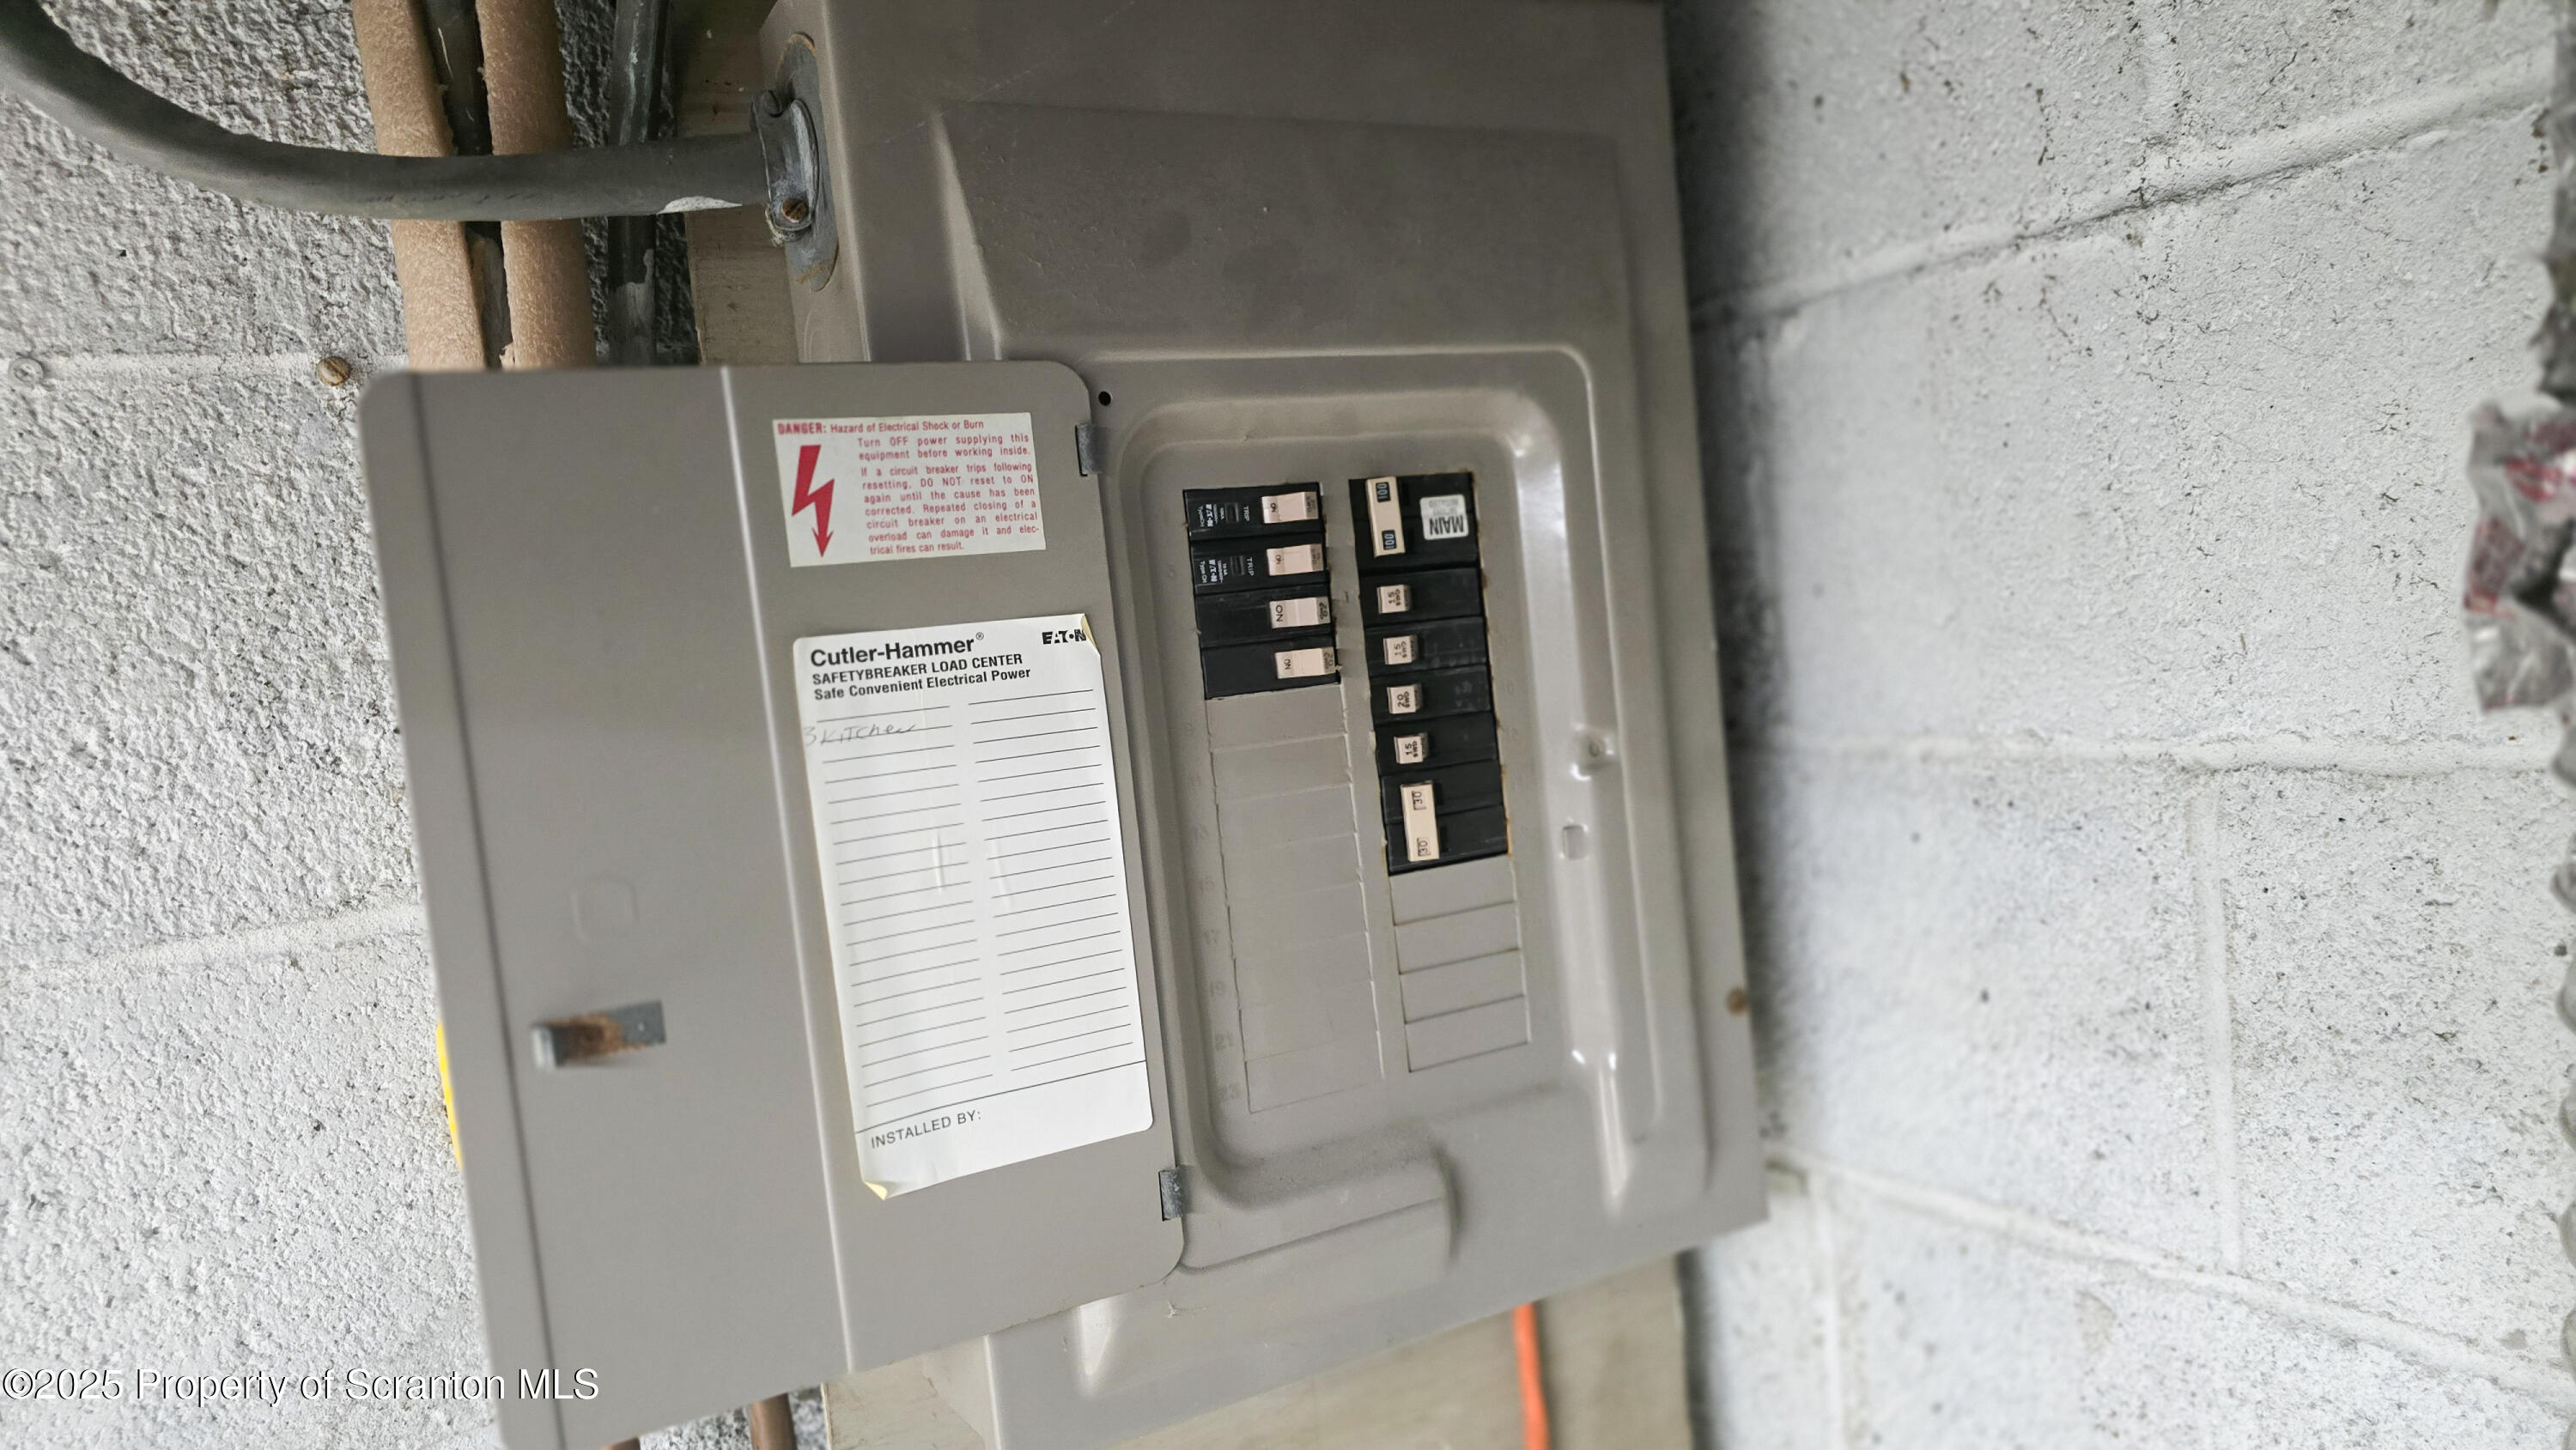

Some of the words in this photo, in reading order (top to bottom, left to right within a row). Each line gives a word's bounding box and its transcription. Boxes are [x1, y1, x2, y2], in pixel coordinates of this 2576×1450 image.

[777, 422, 827, 435] DANGER:
[830, 424, 863, 434] Hazard
[866, 423, 875, 432] of
[878, 422, 919, 433] Electrical
[922, 420, 949, 431] Shock
[952, 421, 961, 430] or
[963, 419, 984, 429] Burn
[858, 437, 881, 447] Turn
[890, 436, 908, 446] OFF
[918, 436, 947, 446] power
[956, 434, 1003, 445] supplying
[1011, 433, 1030, 443] this
[859, 450, 909, 461] equipment
[917, 448, 948, 458] before
[955, 446, 993, 458] working
[1000, 446, 1031, 456] inside.
[861, 466, 867, 476] If
[890, 464, 918, 476] circuit
[926, 464, 959, 475] breaker
[966, 463, 987, 473] trips
[993, 461, 1032, 472] following
[920, 478, 933, 488] DO
[942, 476, 962, 487] NOT
[970, 476, 995, 485] reset
[1003, 475, 1012, 484] to
[1020, 474, 1034, 483] ON
[864, 493, 891, 505] again
[900, 491, 922, 501] until
[930, 490, 946, 501] the
[954, 490, 981, 499] cause
[989, 488, 1006, 497] has
[1014, 487, 1035, 496] been
[1376, 482, 1388, 500] 100
[865, 505, 915, 516] corrected.
[922, 502, 966, 514] Repeated
[974, 501, 1007, 511] closing
[1015, 500, 1024, 509] of
[866, 519, 898, 529] circuit
[908, 516, 944, 527] breaker
[995, 512, 1037, 522] electrical
[1429, 515, 1464, 536] MAIN
[868, 531, 908, 542] overload
[940, 529, 975, 538] damage
[982, 527, 988, 536] it
[996, 525, 1012, 535] and
[1019, 525, 1040, 534] elec-
[1384, 533, 1394, 549] 100
[870, 545, 894, 555] trical
[896, 544, 916, 553] fires
[937, 541, 964, 551] result.
[1388, 592, 1395, 604] 15
[1275, 604, 1284, 622] ON
[1394, 643, 1401, 656] 15
[812, 663, 927, 685] SAFETYBREAKER
[932, 658, 968, 673] LOAD
[972, 653, 1023, 669] CENTER
[814, 688, 845, 701] Safe
[849, 678, 923, 697] Convenient
[927, 673, 987, 689] Electrical
[992, 668, 1031, 682] Power
[1397, 694, 1405, 707] 20
[1405, 743, 1413, 755] 15
[1413, 791, 1423, 805] 30
[1419, 840, 1428, 856] 30
[871, 1116, 951, 1149] INSTALLED
[957, 1110, 981, 1125] BY:
